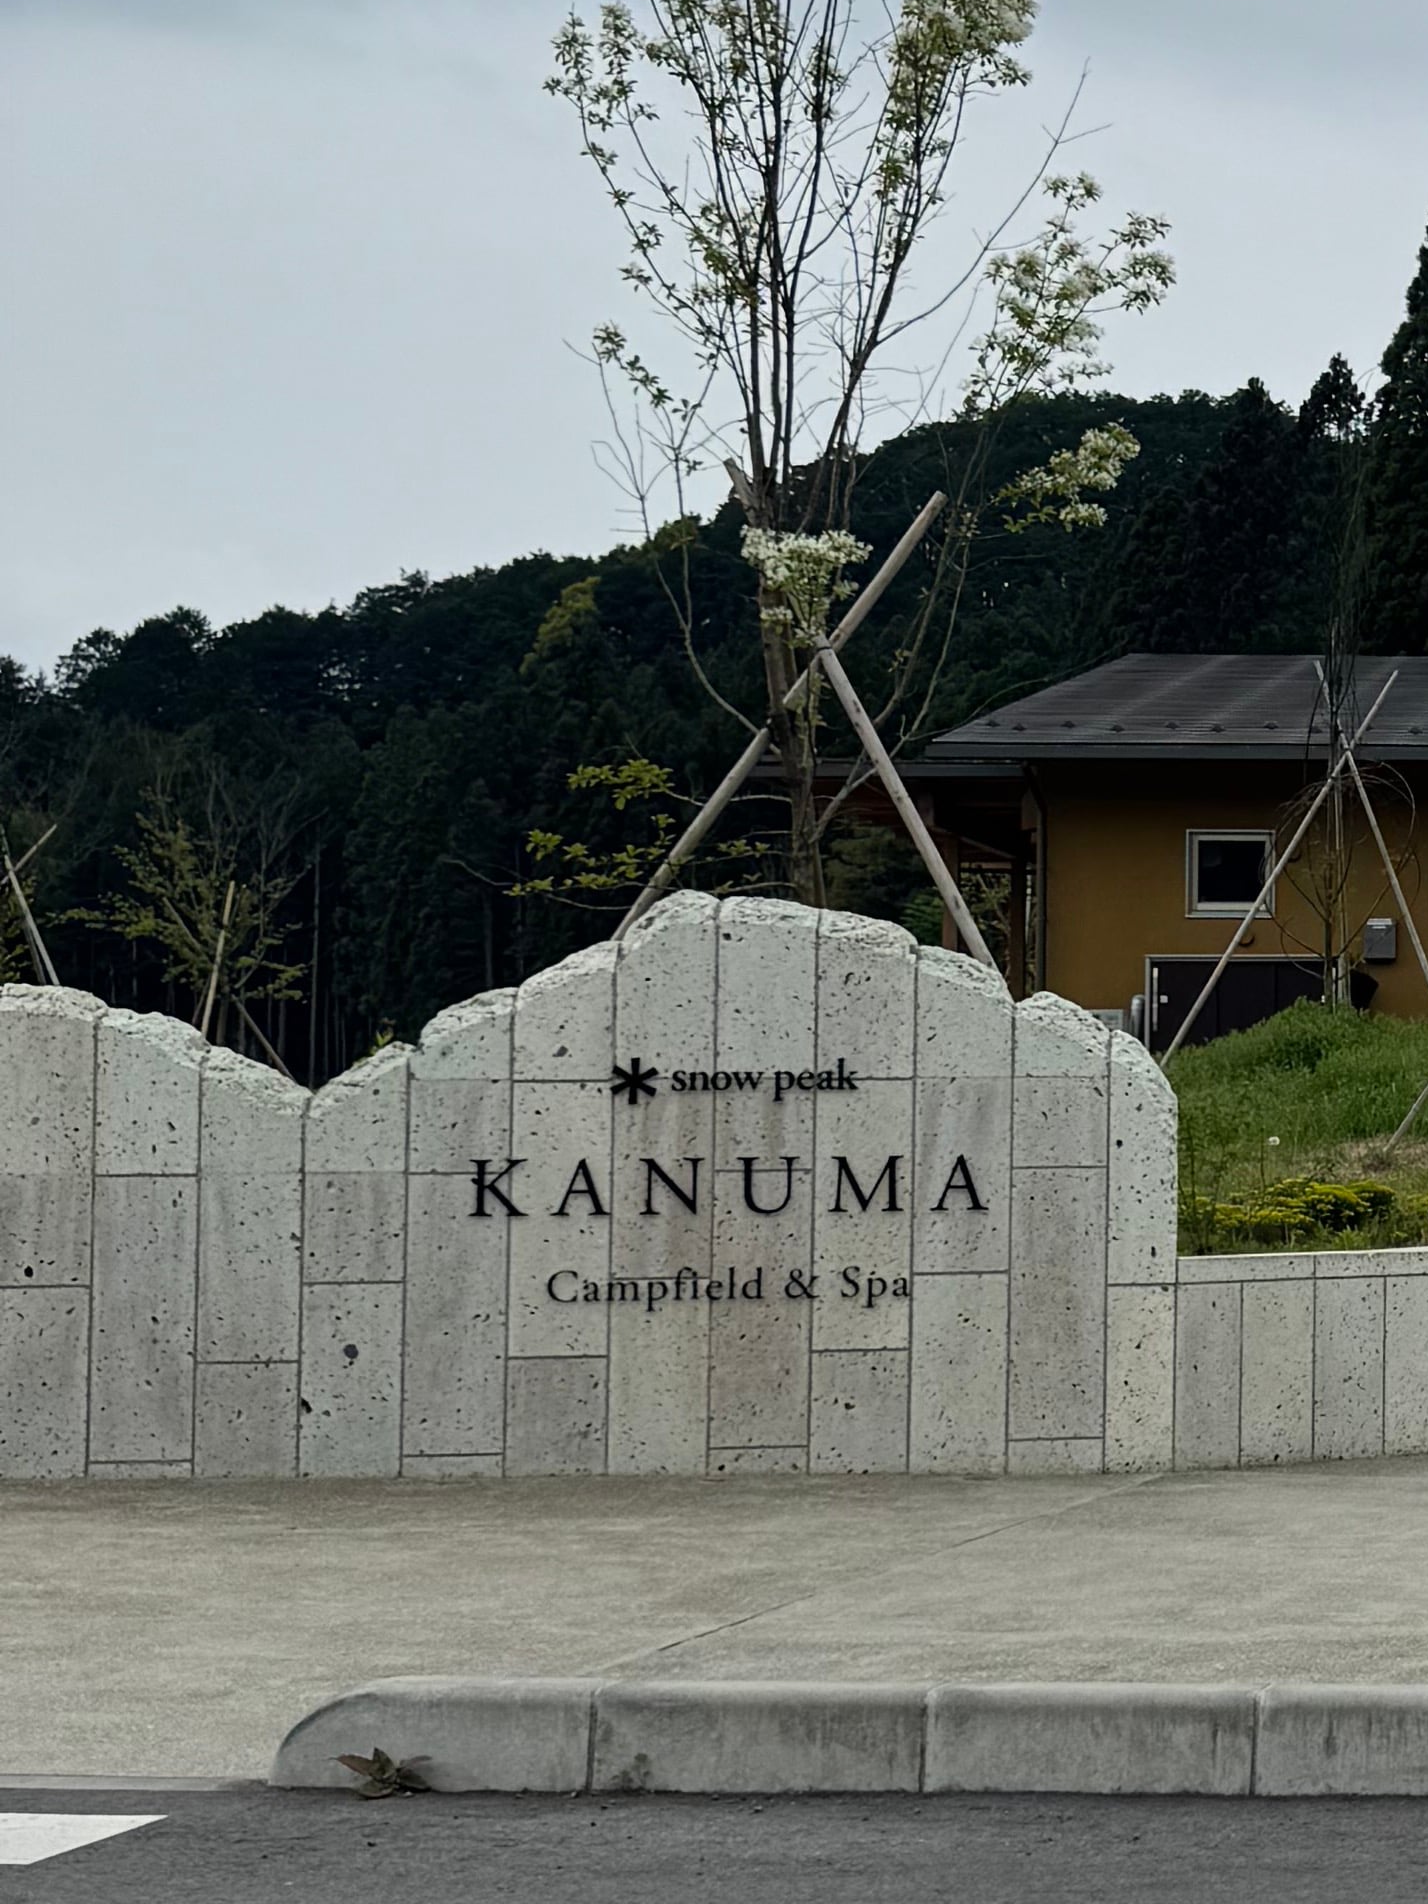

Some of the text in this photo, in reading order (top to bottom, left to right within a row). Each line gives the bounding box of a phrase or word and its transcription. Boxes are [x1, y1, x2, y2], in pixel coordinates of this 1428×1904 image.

[671, 1058, 859, 1100] snow peak
[468, 1154, 990, 1218] KANUMA
[546, 1265, 912, 1312] Campfield & Spa
